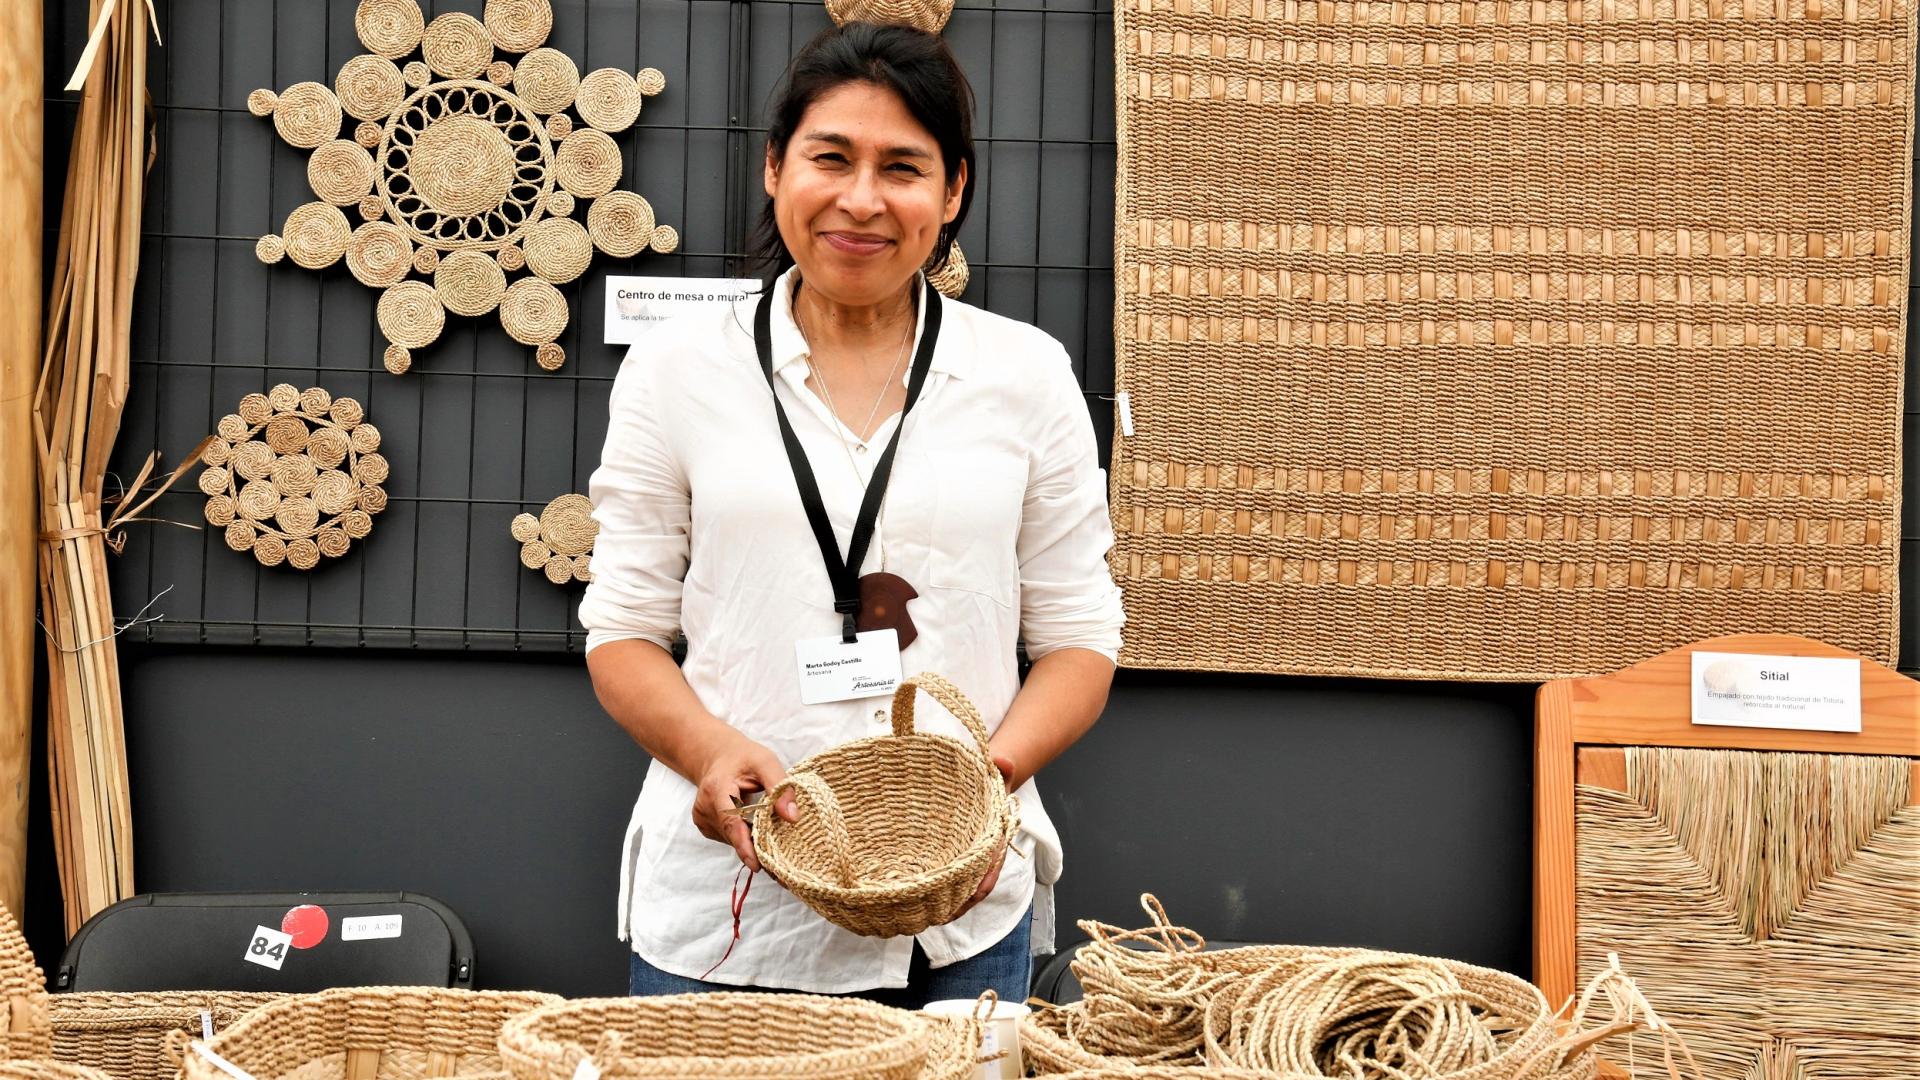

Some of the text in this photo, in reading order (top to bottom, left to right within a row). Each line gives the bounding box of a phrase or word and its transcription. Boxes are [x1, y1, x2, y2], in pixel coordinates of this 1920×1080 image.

[617, 290, 654, 300] Centro
[658, 291, 671, 300] de
[675, 293, 704, 301] mesa
[1760, 670, 1789, 681] Sitial
[1707, 691, 1740, 699] Empajado
[251, 936, 285, 961] 84
